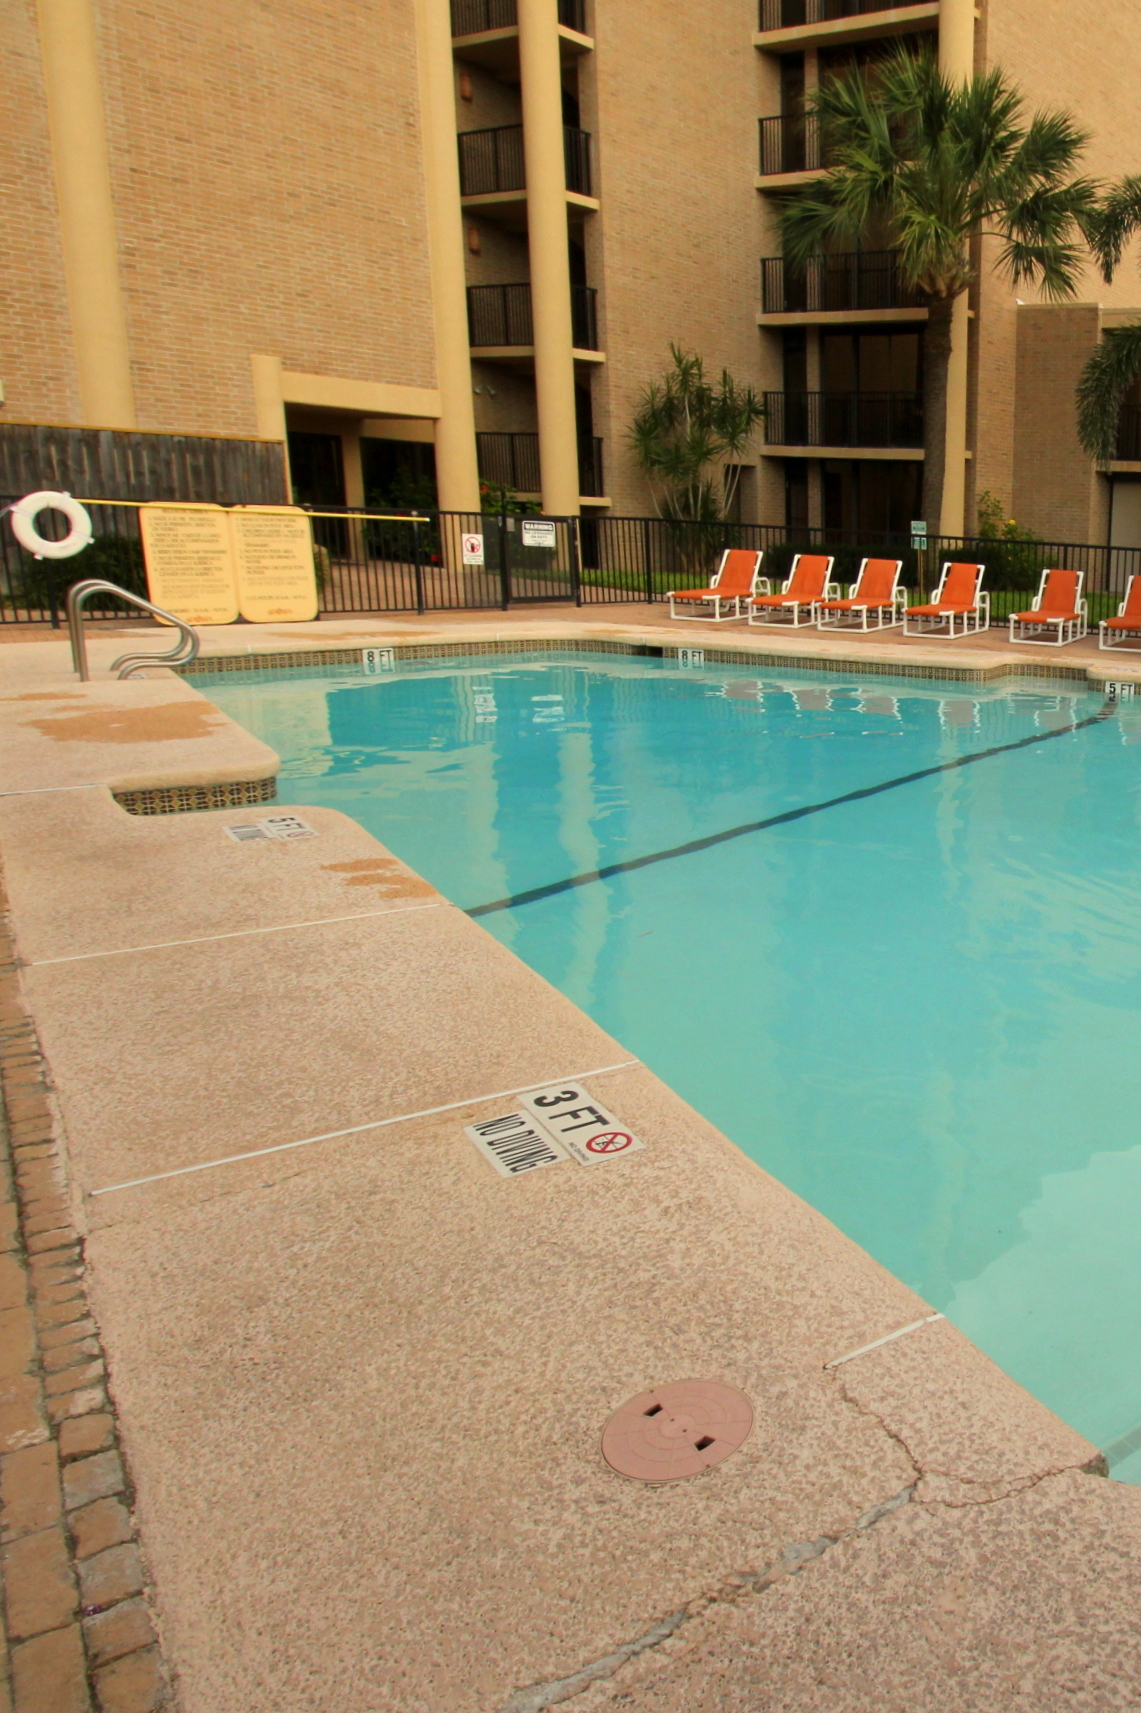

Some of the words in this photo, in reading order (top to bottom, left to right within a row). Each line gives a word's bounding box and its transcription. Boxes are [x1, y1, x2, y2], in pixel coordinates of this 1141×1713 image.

[367, 650, 375, 662] 8
[380, 649, 392, 661] FT
[1109, 683, 1116, 693] 5
[1121, 684, 1133, 695] FT
[533, 1090, 579, 1108] 3
[472, 1113, 527, 1136] NO
[548, 1105, 610, 1133] FT
[486, 1129, 558, 1174] DIVING
